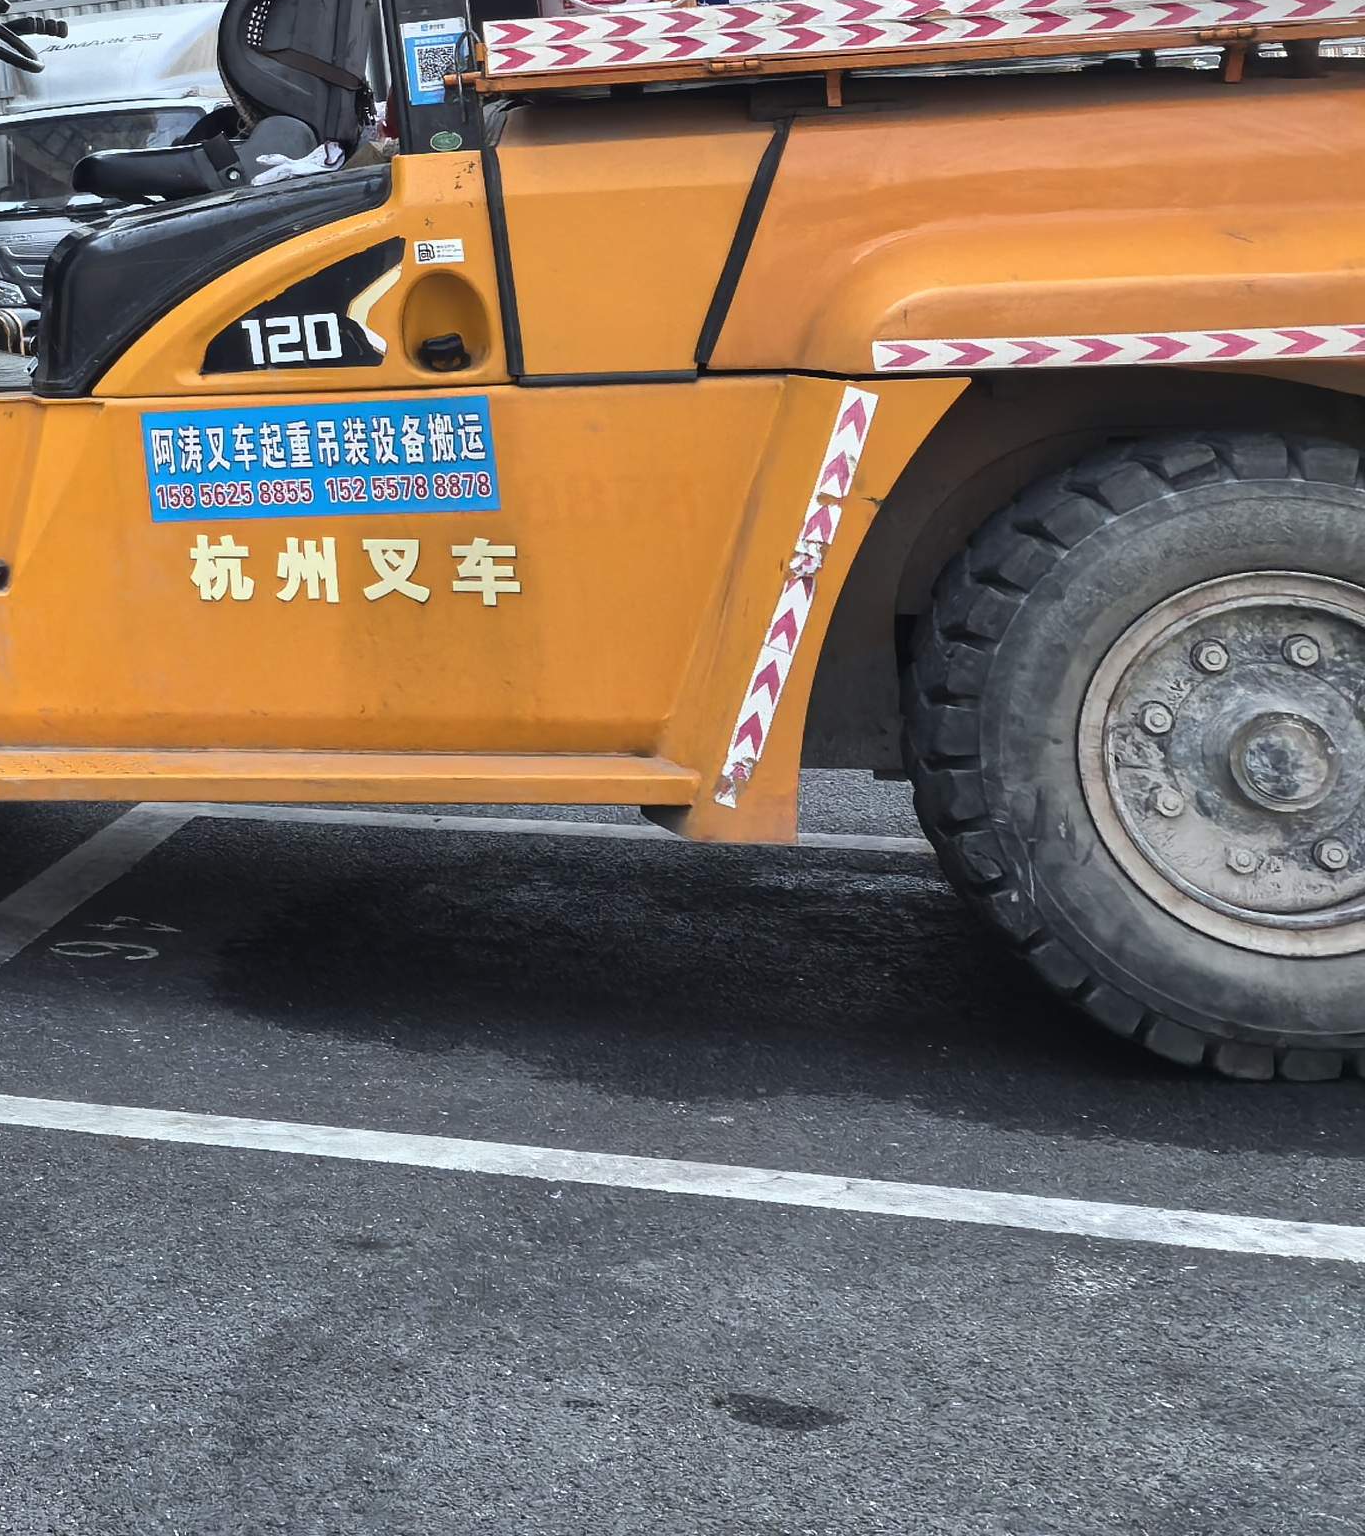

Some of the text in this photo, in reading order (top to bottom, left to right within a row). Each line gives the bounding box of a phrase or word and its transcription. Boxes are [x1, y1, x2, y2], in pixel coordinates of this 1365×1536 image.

[241, 312, 342, 365] 120
[150, 413, 486, 476] 阿涛叉车起重吊装设备搬运
[155, 471, 492, 510] 158 5625 8855 152 5578 8878
[189, 534, 522, 607] 杭州叉车
